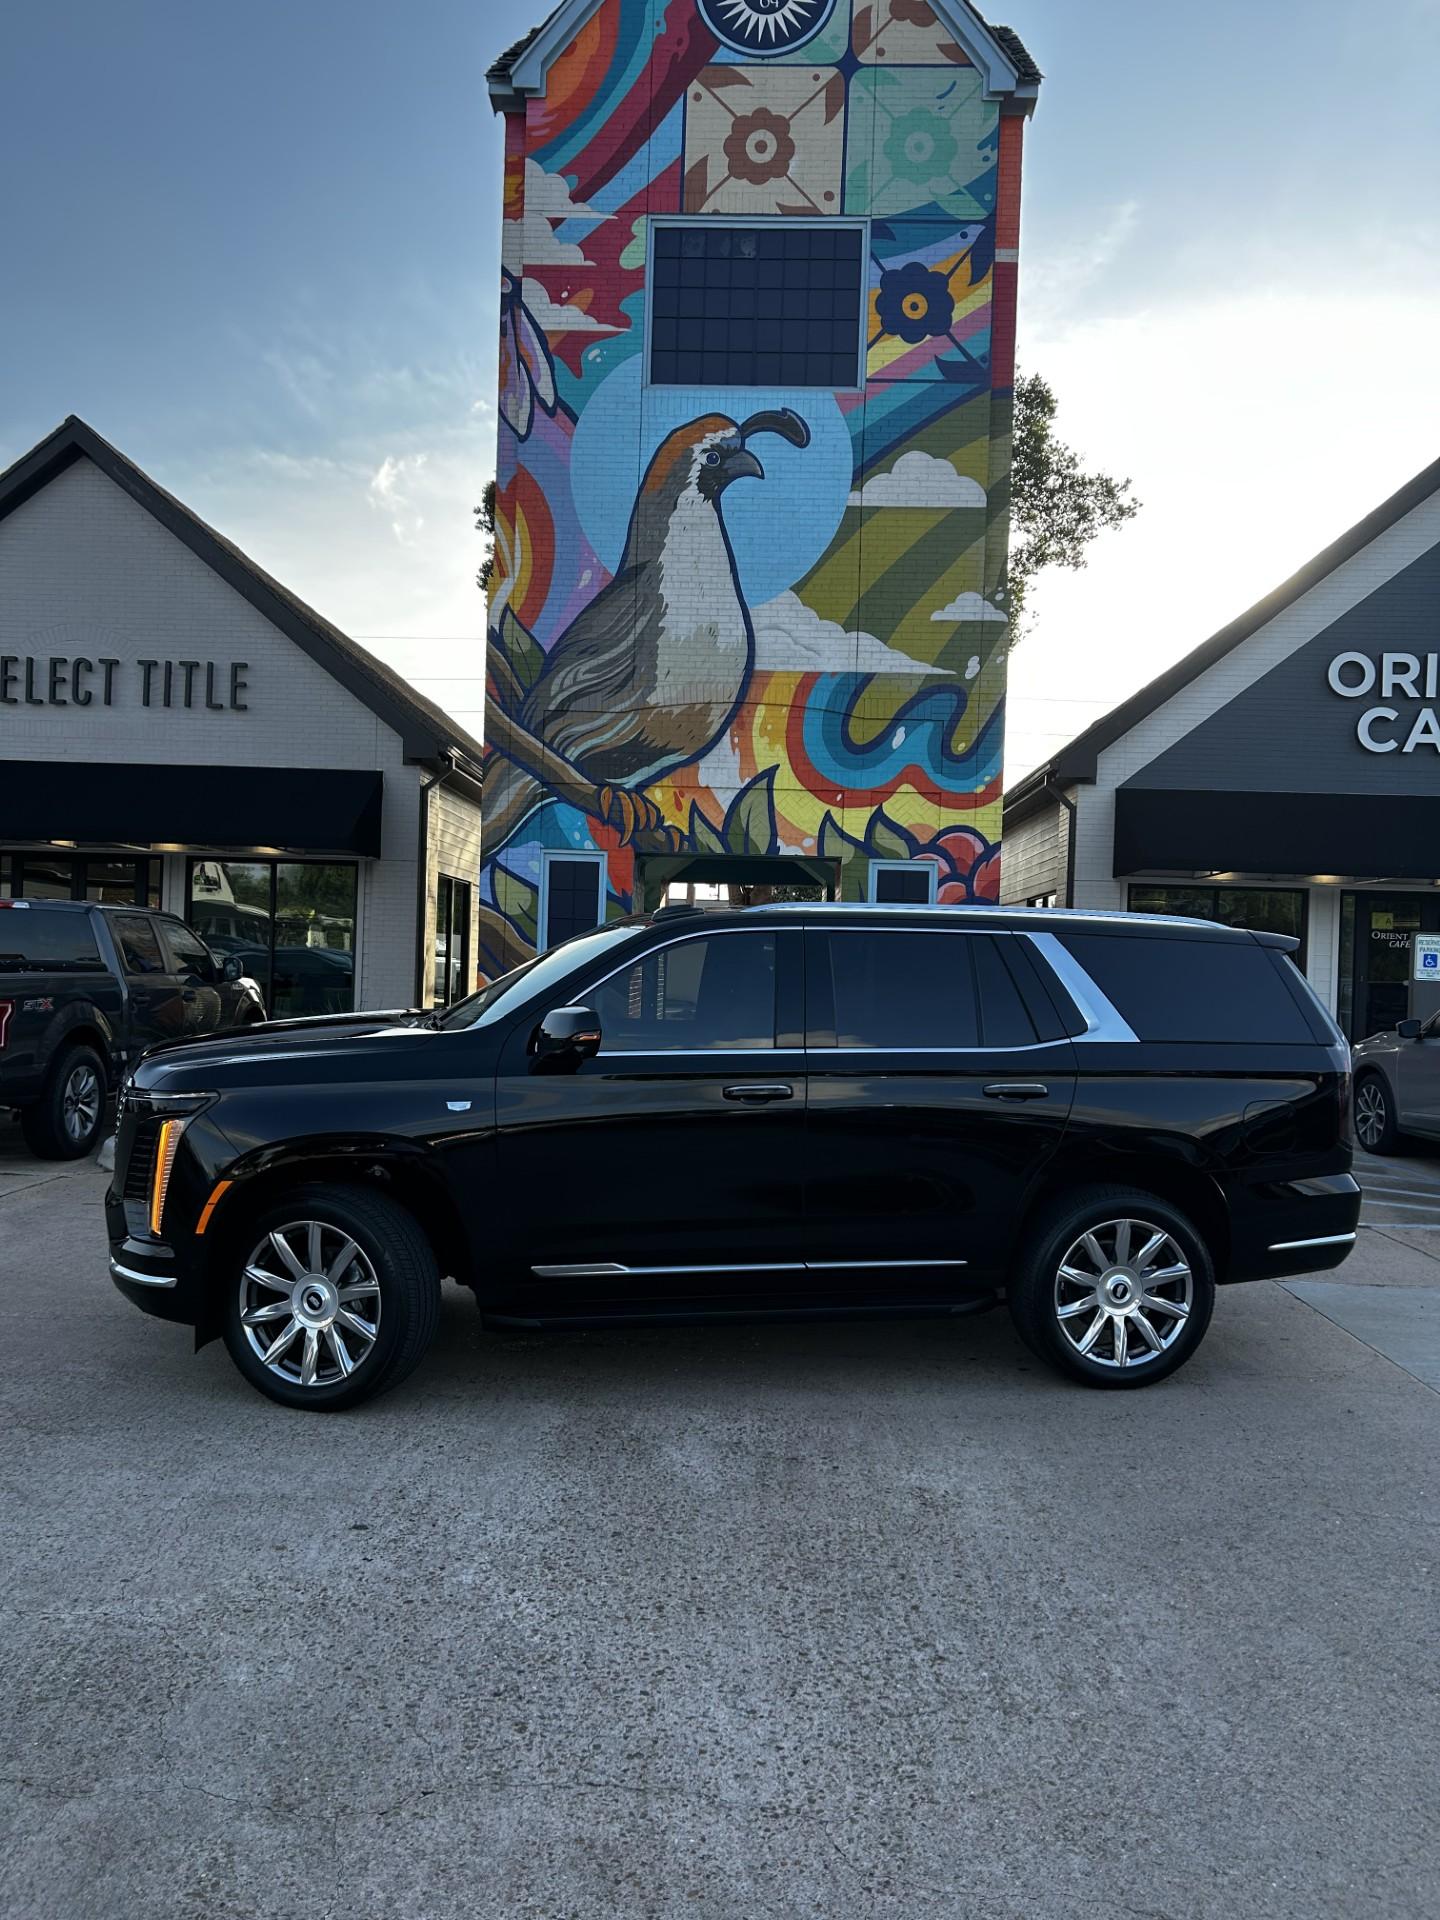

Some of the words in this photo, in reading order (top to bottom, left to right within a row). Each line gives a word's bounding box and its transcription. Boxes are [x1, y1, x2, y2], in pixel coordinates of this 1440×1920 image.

[0, 655, 120, 706] ELECT
[136, 659, 248, 710] TITLE
[1327, 651, 1438, 698] ORI
[1357, 706, 1440, 753] CA
[23, 997, 54, 1010] STX
